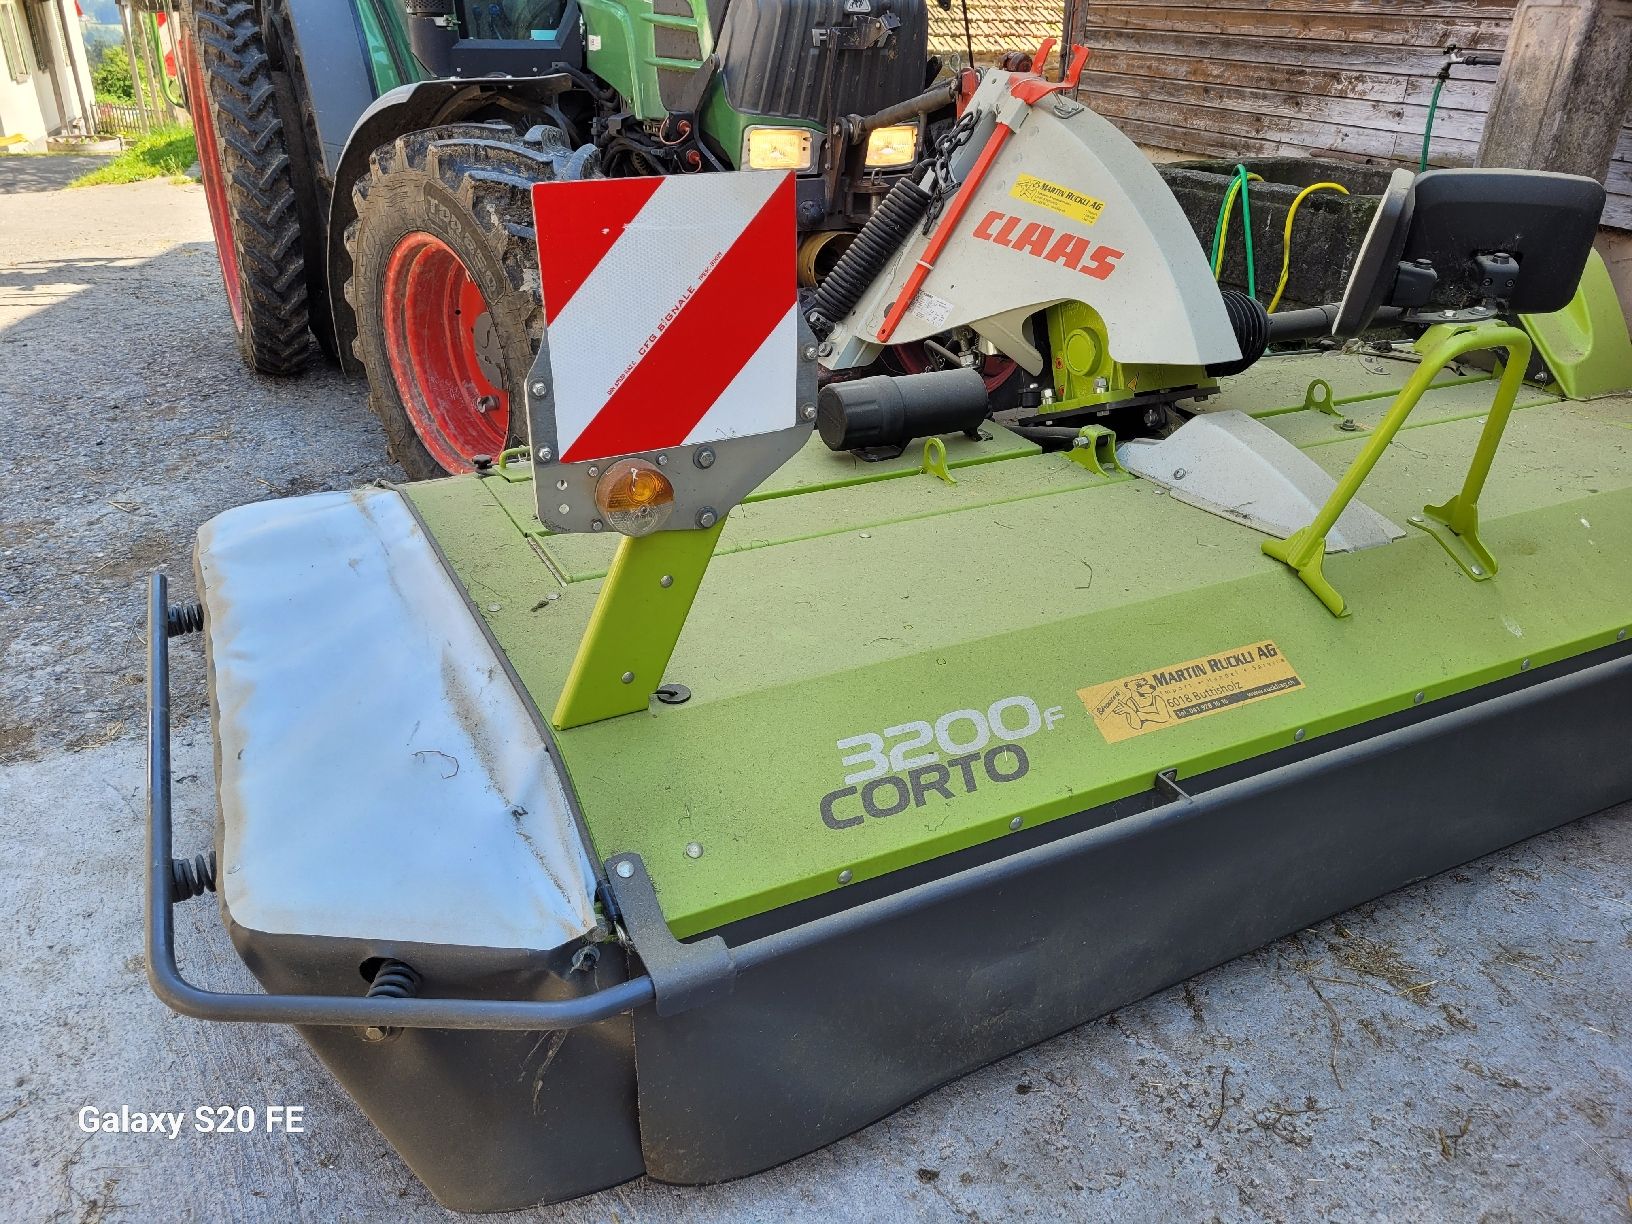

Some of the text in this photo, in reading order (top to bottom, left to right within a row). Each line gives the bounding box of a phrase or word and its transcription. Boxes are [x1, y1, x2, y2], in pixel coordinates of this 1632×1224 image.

[1089, 201, 1104, 211] AG
[973, 210, 1125, 281] CLAAS
[638, 333, 658, 356] CFG
[657, 285, 696, 332] SIGNALE
[1152, 643, 1278, 688] MARTIN RUCKLI AG
[1166, 680, 1243, 708] 6018 Buttisholz
[819, 743, 1030, 830] CORTO
